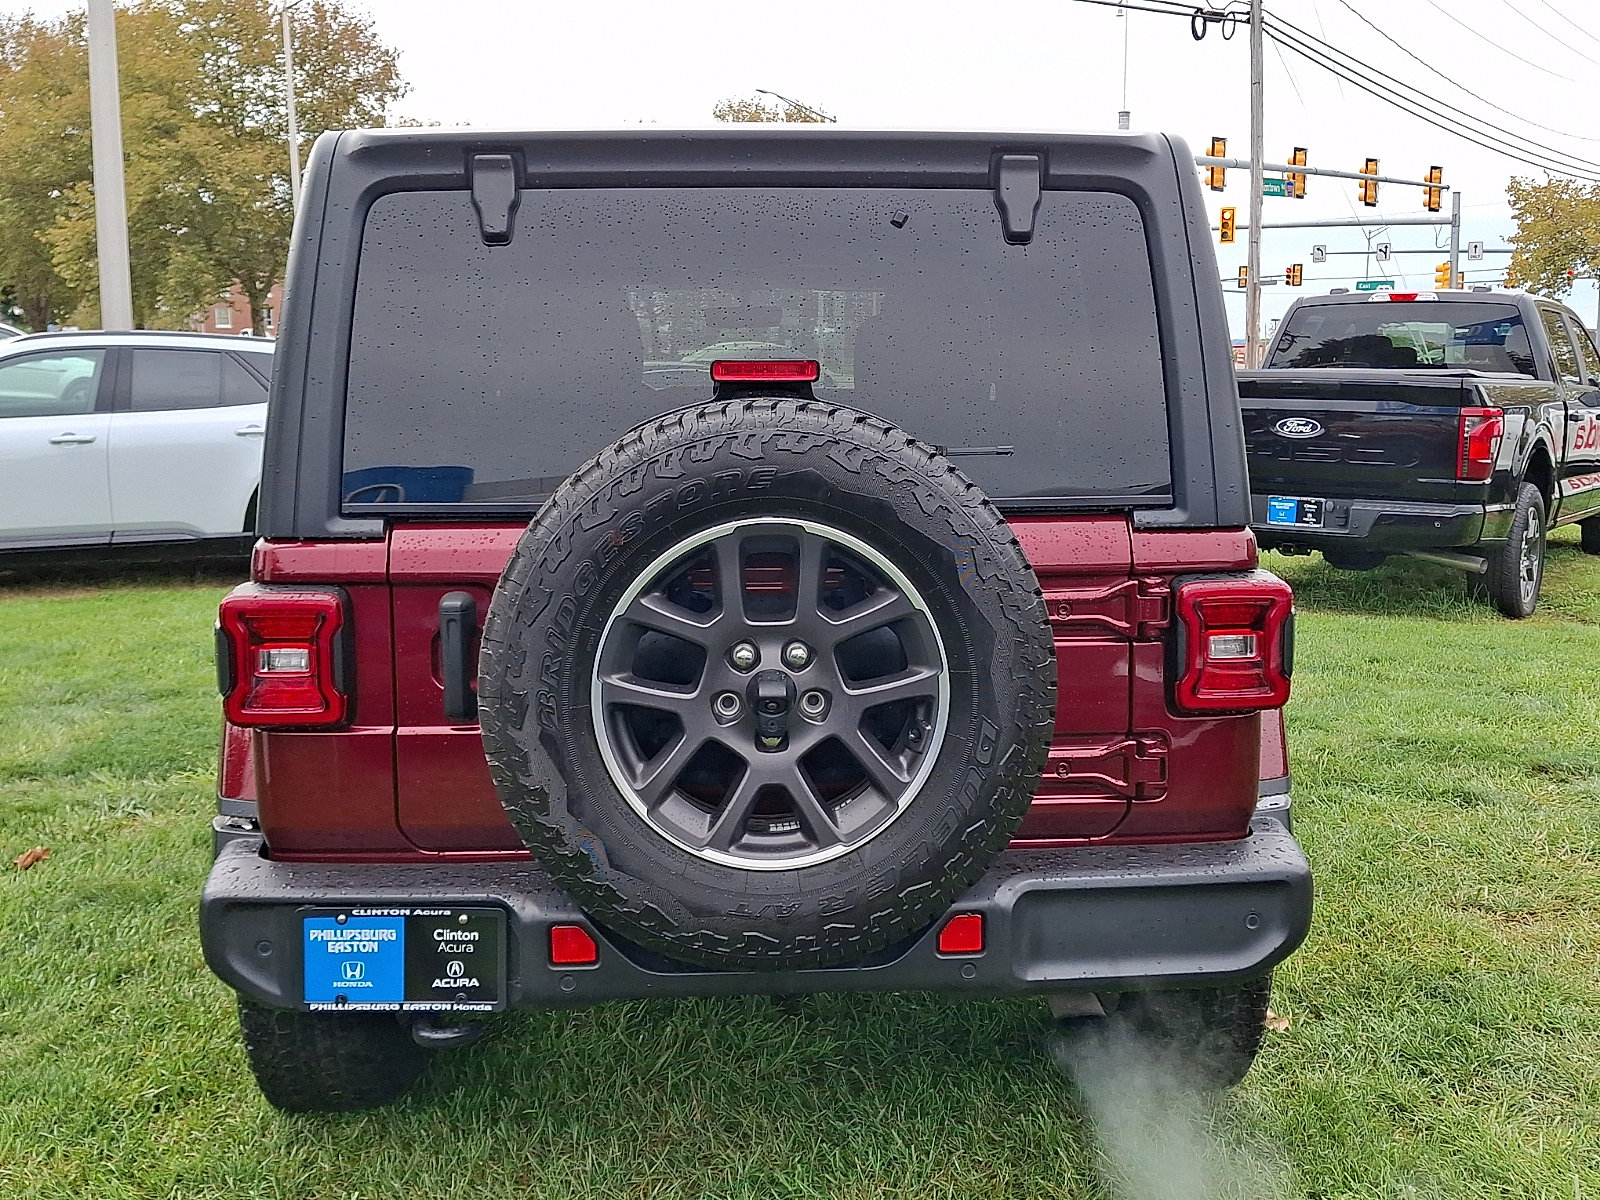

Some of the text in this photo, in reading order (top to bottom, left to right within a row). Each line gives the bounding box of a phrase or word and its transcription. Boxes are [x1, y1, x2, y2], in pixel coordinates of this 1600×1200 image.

[1283, 420, 1313, 433] Ford
[537, 465, 779, 732] BRIDGESTONE
[309, 929, 397, 941] PHILLIPSBURG
[433, 929, 479, 941] Clinton
[327, 941, 379, 953] EASTON
[437, 942, 474, 953] Acura
[431, 978, 480, 988] ACURA
[309, 1003, 493, 1012] PHILLIPSBURG EASTON Honda
